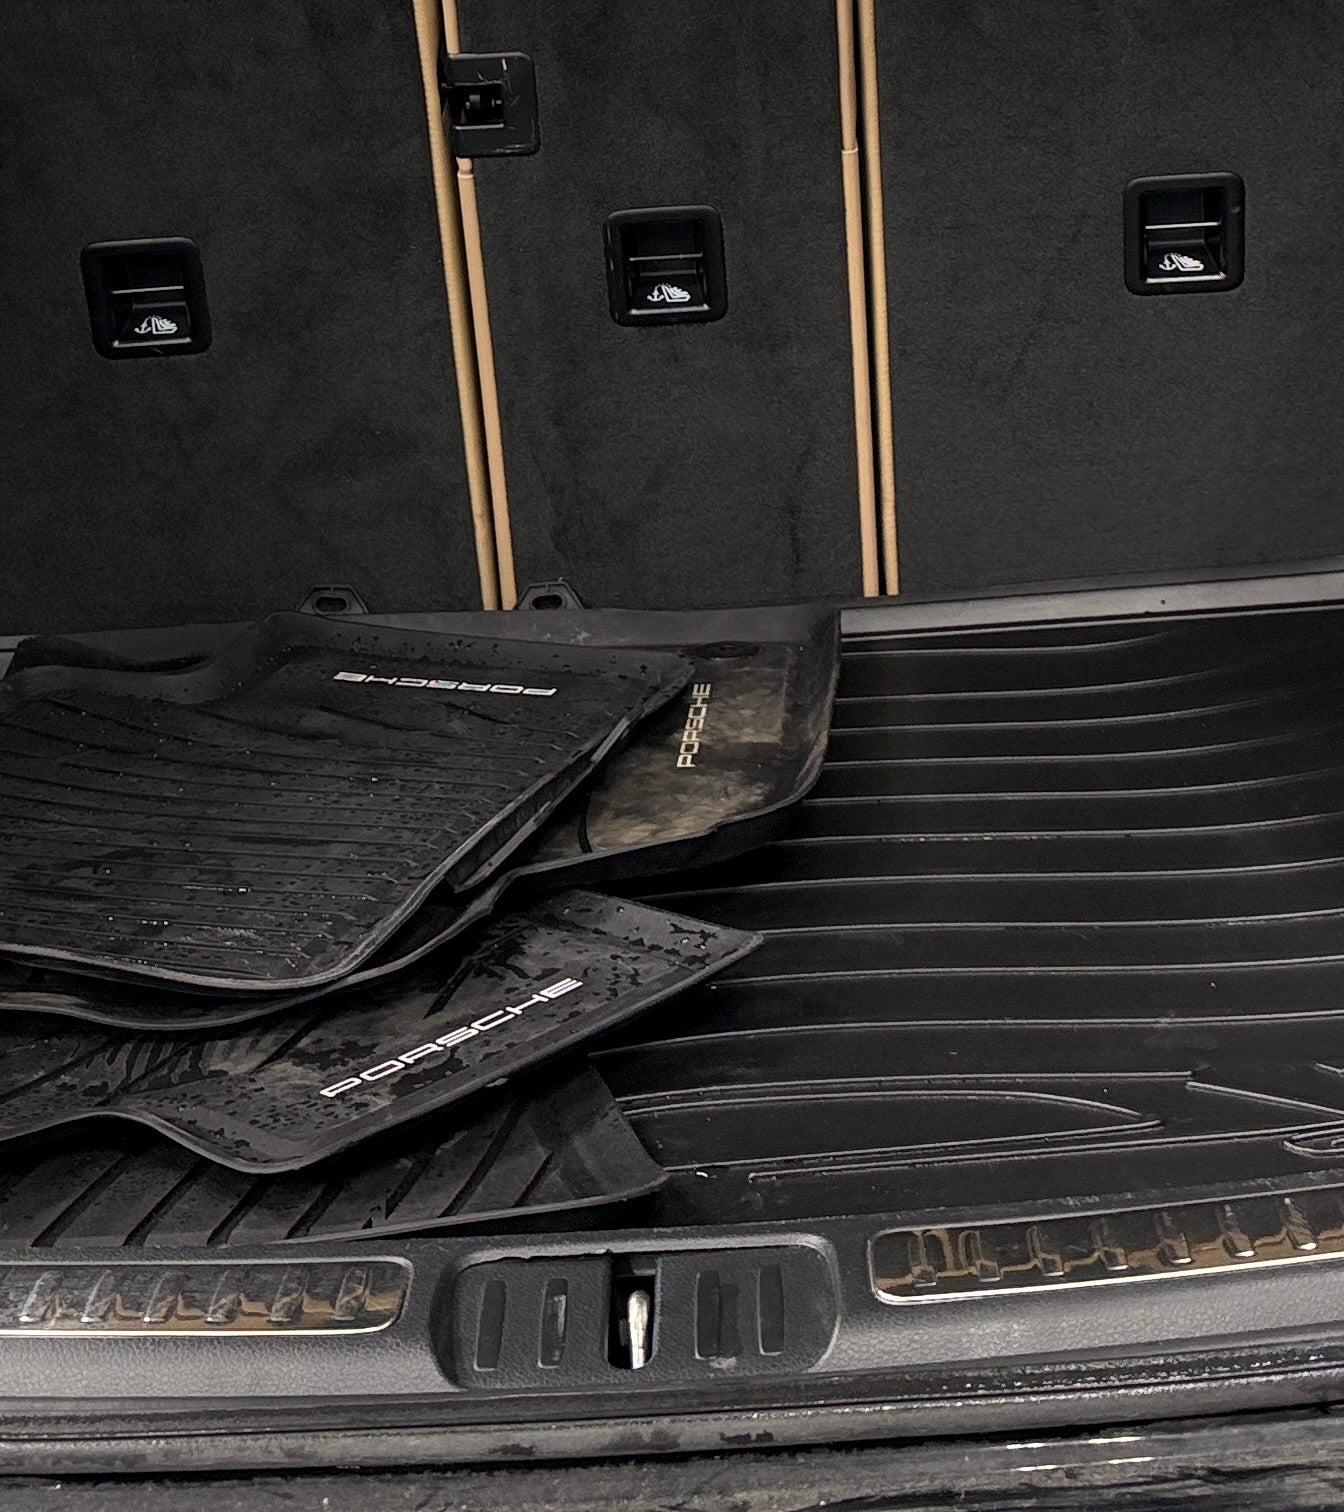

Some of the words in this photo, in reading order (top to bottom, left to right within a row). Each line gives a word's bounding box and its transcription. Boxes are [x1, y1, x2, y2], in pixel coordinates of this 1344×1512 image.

[333, 671, 557, 696] PORSCHE
[676, 683, 712, 768] PORSCHE
[319, 978, 584, 1098] PORSCHE
